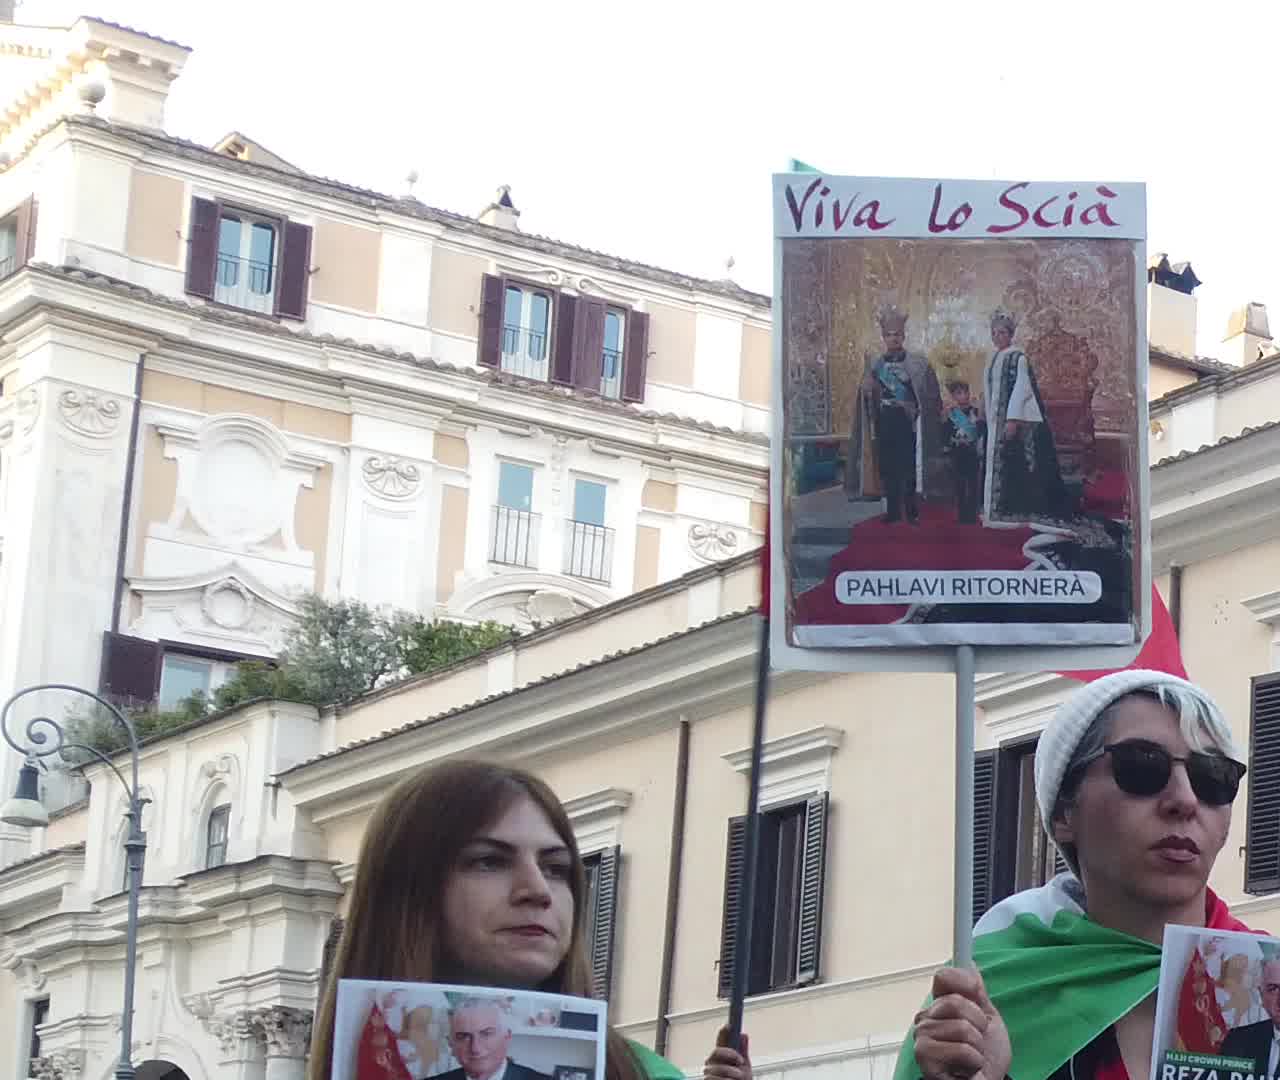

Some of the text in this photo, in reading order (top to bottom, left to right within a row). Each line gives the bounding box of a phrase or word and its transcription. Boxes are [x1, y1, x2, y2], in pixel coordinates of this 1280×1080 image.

[785, 177, 895, 233] Viva
[986, 181, 1121, 233] Scià
[846, 571, 1086, 597] PAHLAVI RITORNERÀ
[1188, 1055, 1222, 1067] CROWN
[1223, 1058, 1254, 1070] PRINCE
